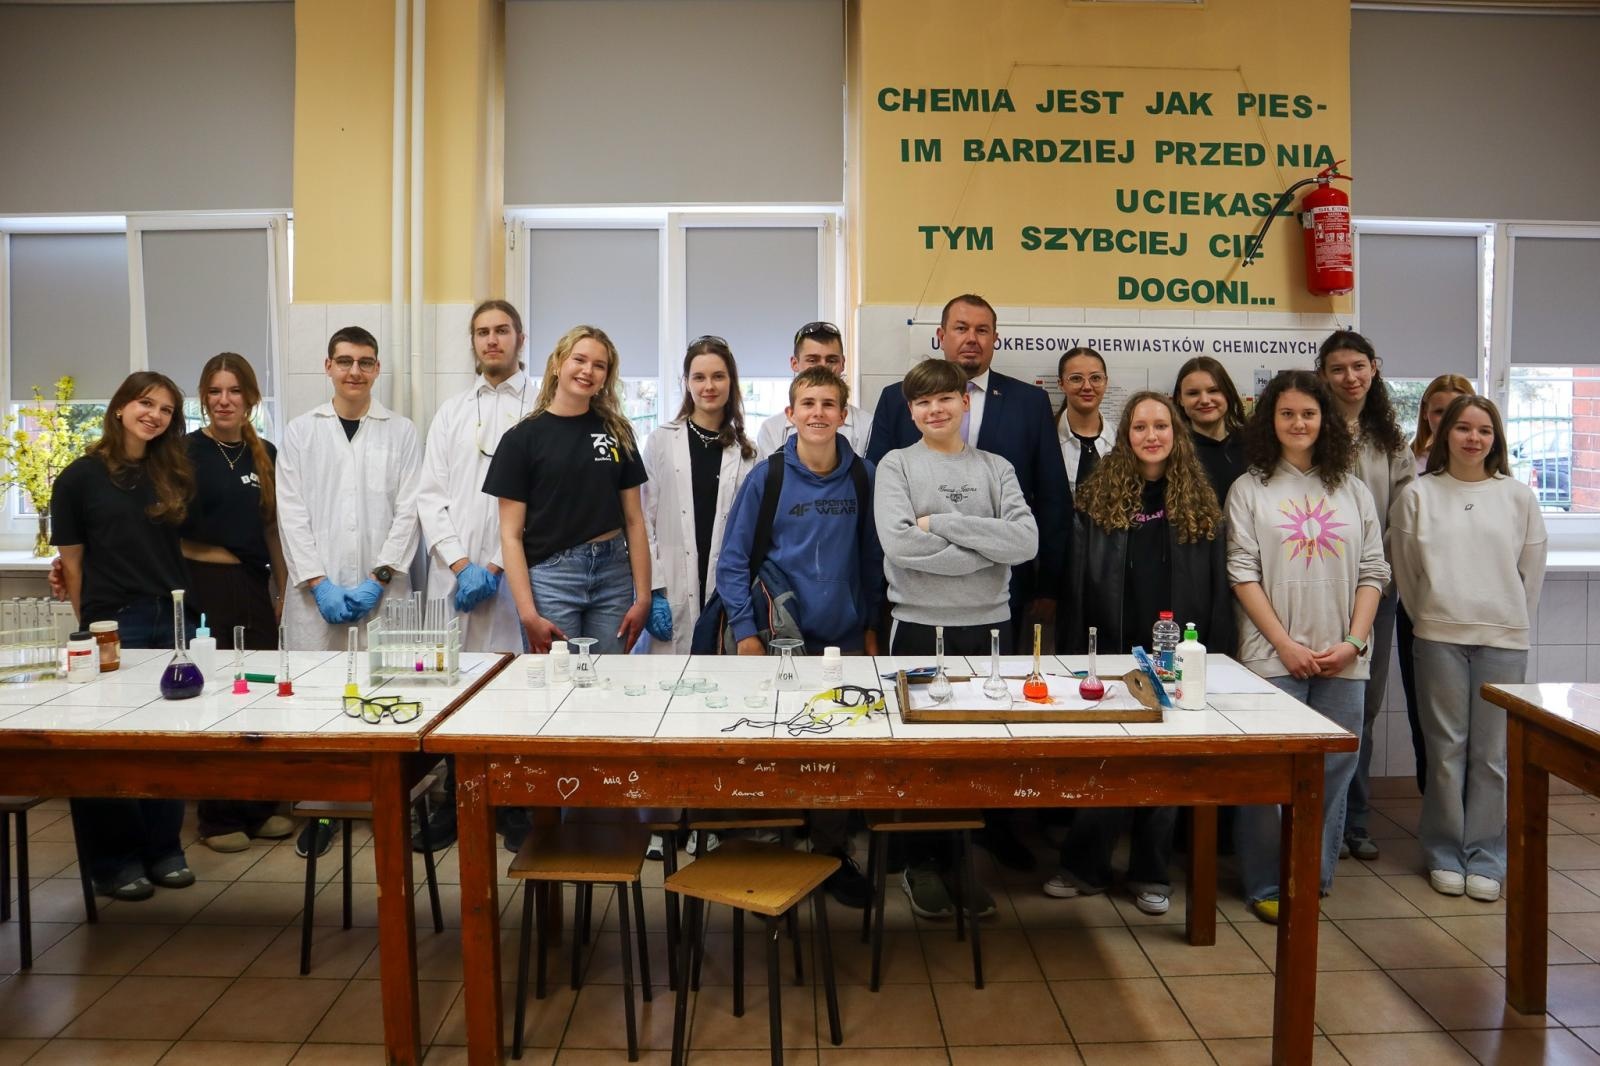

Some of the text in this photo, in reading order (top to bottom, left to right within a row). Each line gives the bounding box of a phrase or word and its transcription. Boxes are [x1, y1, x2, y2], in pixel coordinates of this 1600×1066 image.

[878, 87, 1016, 112] CHEMIA
[1036, 89, 1124, 114] JEST
[1146, 92, 1213, 116] JAK
[900, 139, 942, 162] IM
[963, 139, 1136, 164] BARDZIEJ
[1155, 141, 1267, 167] PRZED
[919, 226, 994, 250] TYM
[1021, 226, 1189, 256] SZYBCIEJ
[1118, 277, 1276, 305] DOGONI...
[993, 336, 1317, 354] OKRESOWY PIERWIASTKÓW CHEMICZNYCH
[815, 499, 856, 507] SPORTS
[815, 507, 856, 515] WEAR
